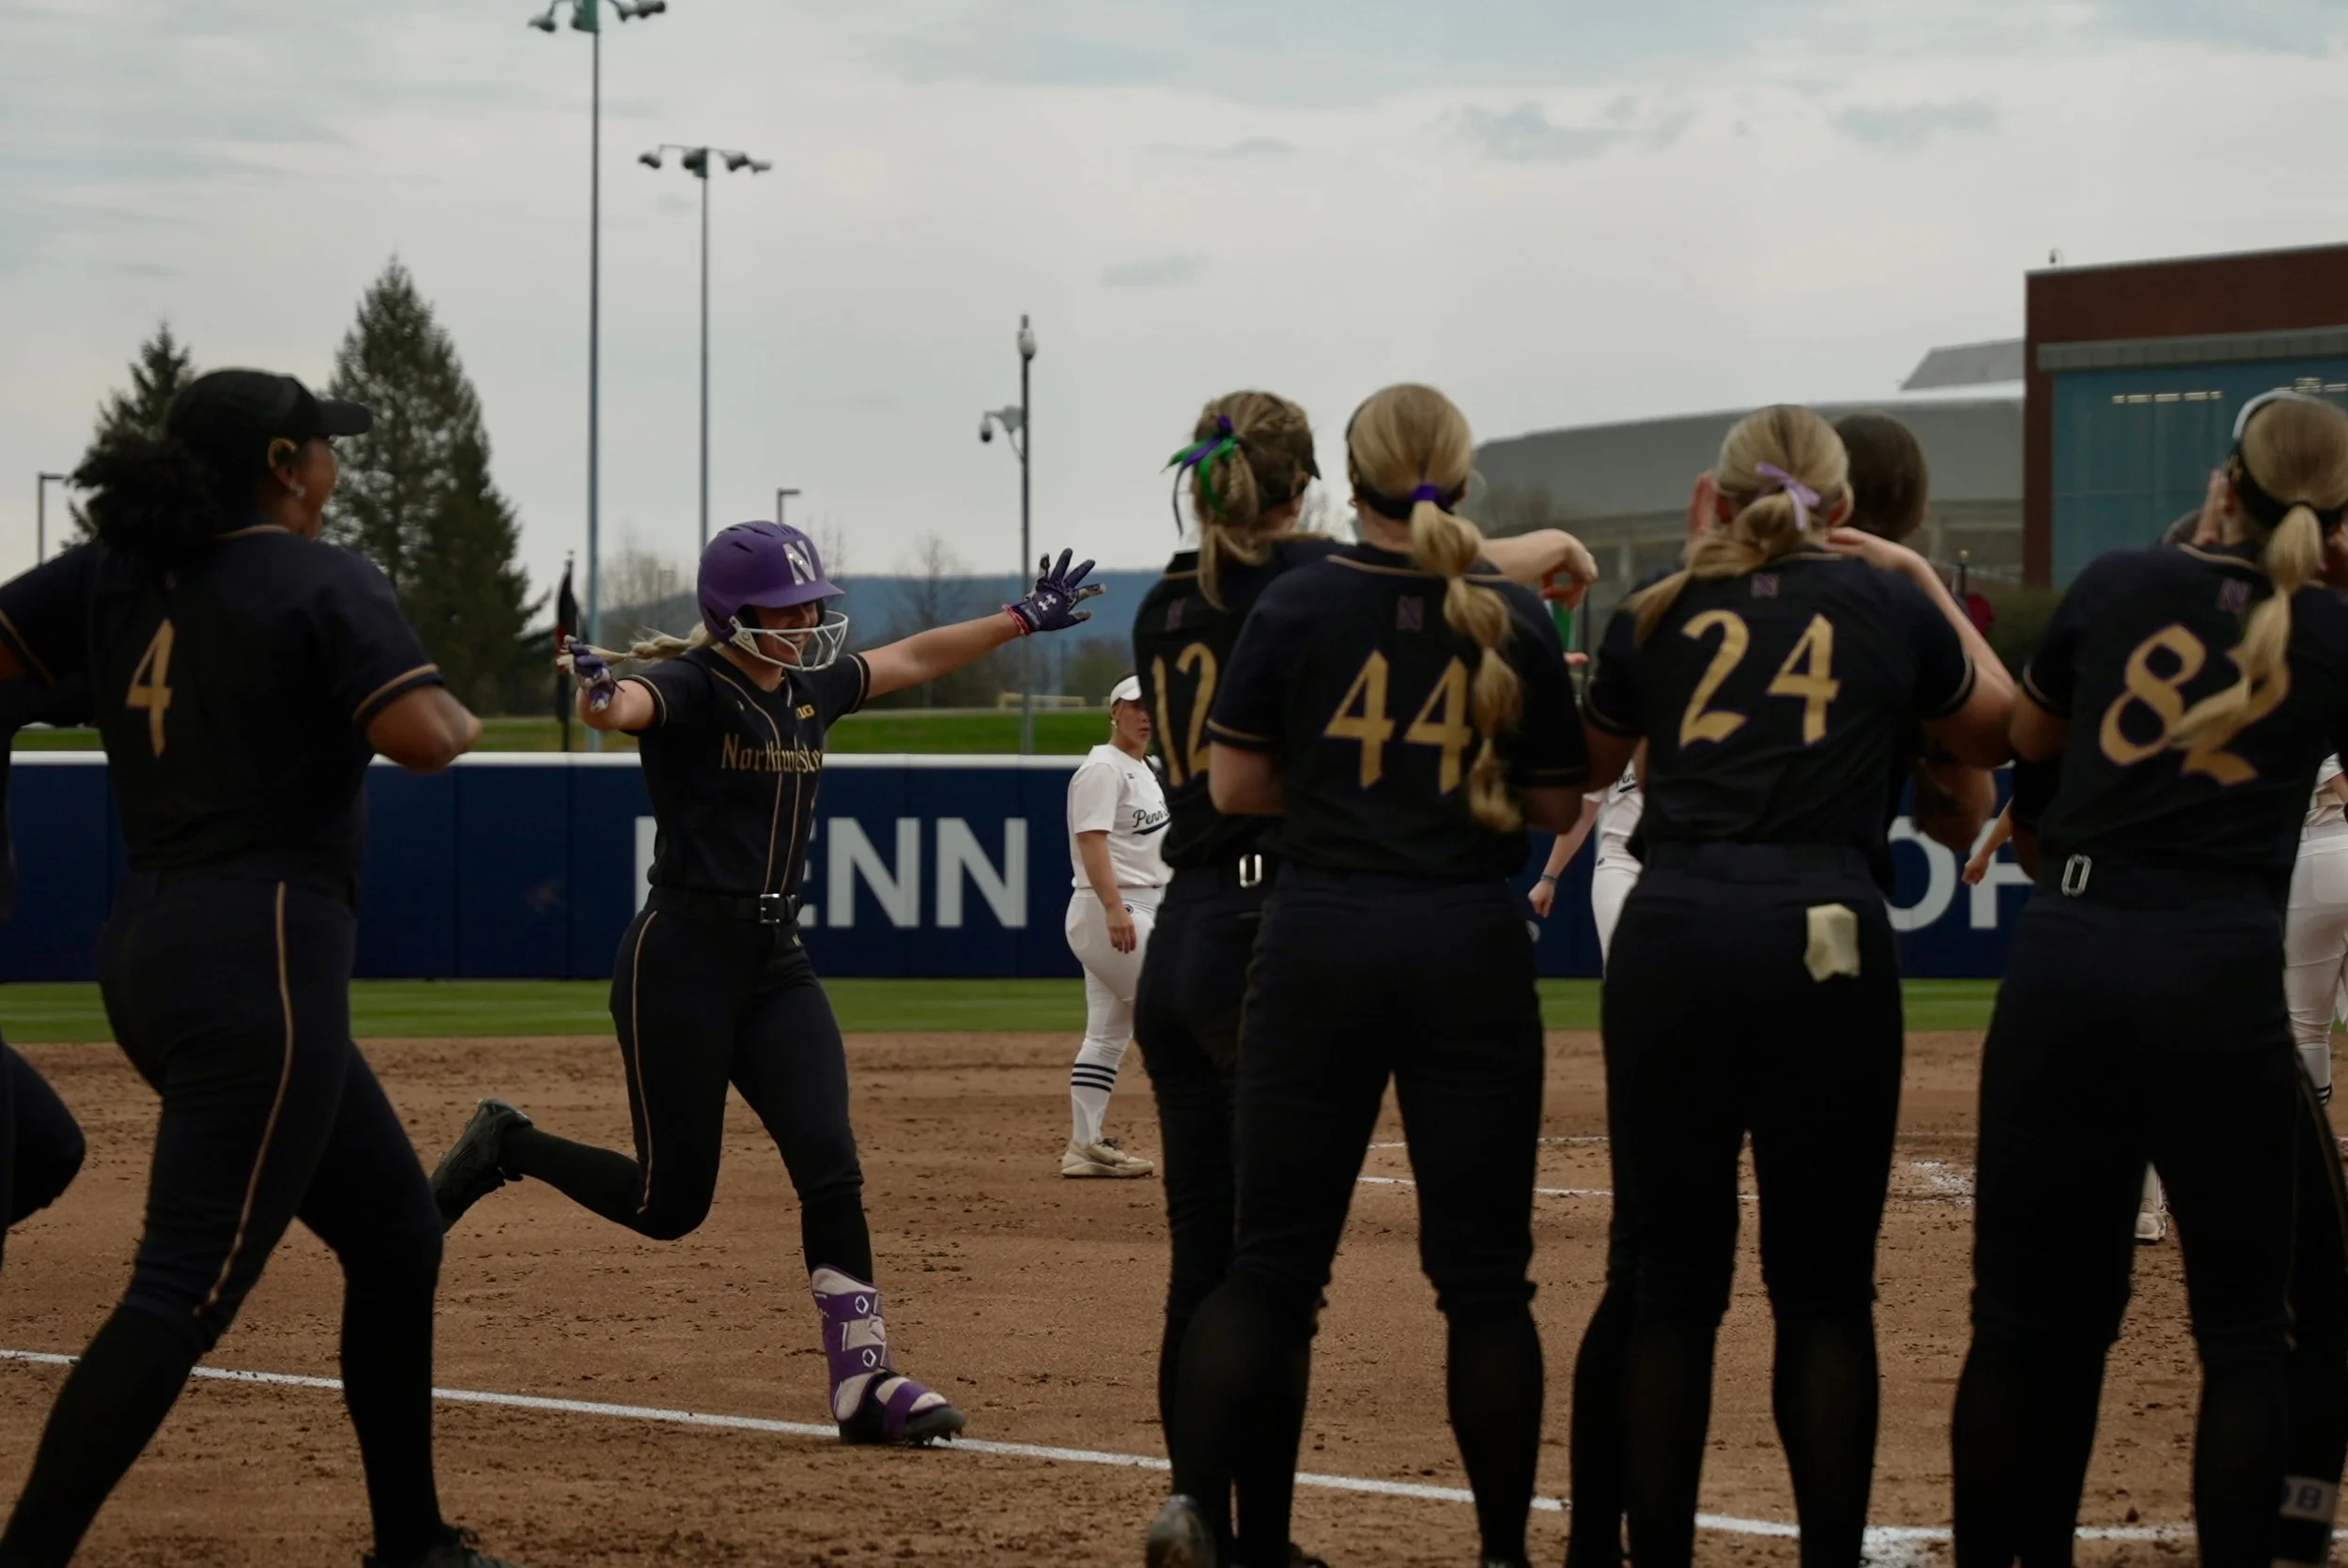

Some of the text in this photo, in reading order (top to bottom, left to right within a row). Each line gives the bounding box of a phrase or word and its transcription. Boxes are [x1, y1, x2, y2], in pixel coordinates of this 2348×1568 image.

[782, 540, 817, 586] N
[125, 617, 176, 759] 4
[1150, 641, 1218, 788] 12
[1322, 647, 1474, 797] 44
[1678, 608, 1842, 748] 24
[2098, 622, 2292, 788] 82
[1132, 809, 1164, 828] Penn
